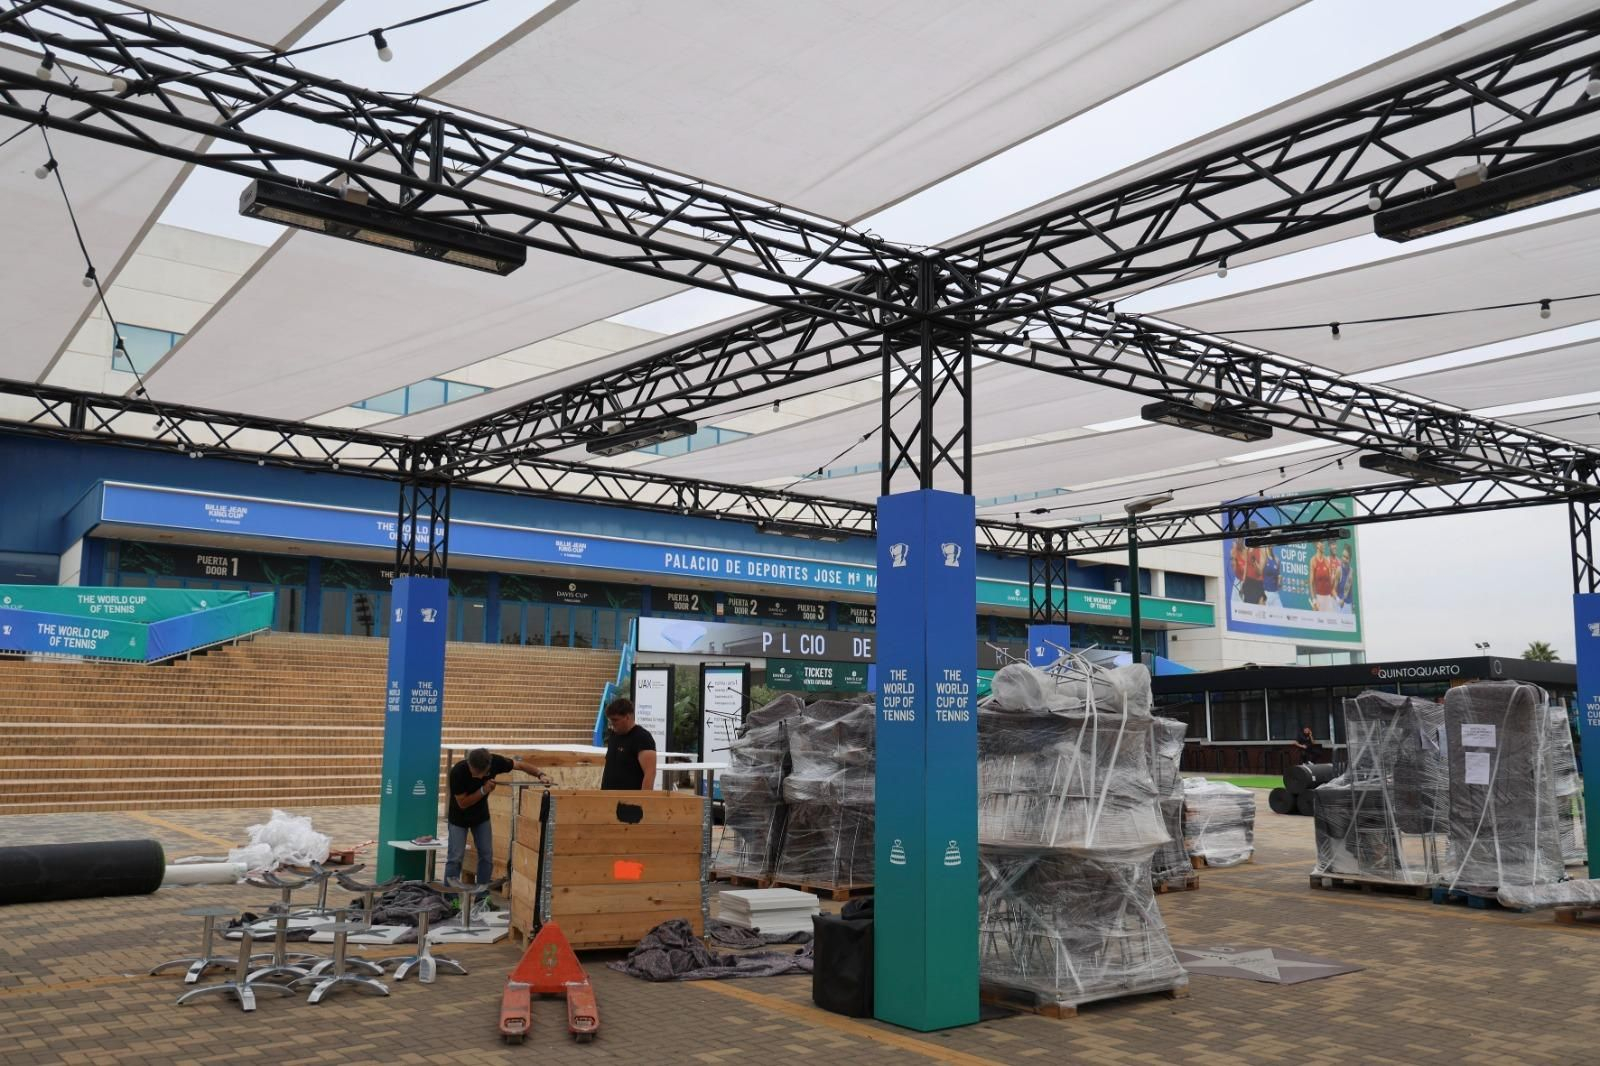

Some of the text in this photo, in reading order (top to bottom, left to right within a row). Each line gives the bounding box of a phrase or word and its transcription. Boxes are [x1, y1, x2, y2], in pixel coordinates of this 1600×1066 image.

[205, 503, 248, 514] BILLIE JEAN
[377, 521, 396, 531] THE
[197, 554, 228, 567] PUERTA
[1281, 548, 1307, 562] CUP OF
[205, 565, 227, 577] DOOR
[231, 557, 239, 577] 1
[664, 553, 719, 572] PALACIO
[725, 560, 740, 574] DE
[748, 561, 808, 581] DEPORTES
[814, 568, 842, 584] JOSE
[1280, 561, 1309, 575] TENNIS
[77, 595, 147, 605] THE WORLD CUP
[556, 590, 574, 598] DAVIS
[668, 592, 689, 602] PUERTA
[674, 601, 689, 610] DOOR
[691, 595, 699, 610] 2
[729, 598, 749, 607] PUERTA
[750, 600, 758, 615] 2
[797, 604, 816, 612] PUERTA
[89, 605, 135, 614] OF TENNIS
[734, 606, 749, 615] DOOR
[803, 611, 816, 620] DOOR
[818, 605, 825, 620] 3
[851, 609, 869, 617] PUERTA
[856, 616, 868, 624] DOOR
[869, 609, 876, 624] 3
[37, 623, 109, 640] THE WORLD CUP
[49, 636, 97, 649] OF TENNIS
[853, 637, 872, 657] DE
[804, 667, 833, 678] TICKETS
[890, 669, 908, 681] THE
[943, 669, 962, 681] THE
[1377, 664, 1460, 679] QUINTOQUARTO
[418, 681, 433, 689] THE
[638, 680, 652, 689] UAX
[883, 683, 915, 694] WORLD
[936, 683, 969, 695] WORLD
[411, 689, 438, 697] WORLD
[883, 696, 914, 708] CUP OF
[936, 696, 968, 708] CUP OF
[882, 710, 915, 721] TENNIS
[936, 710, 970, 722] TENNIS
